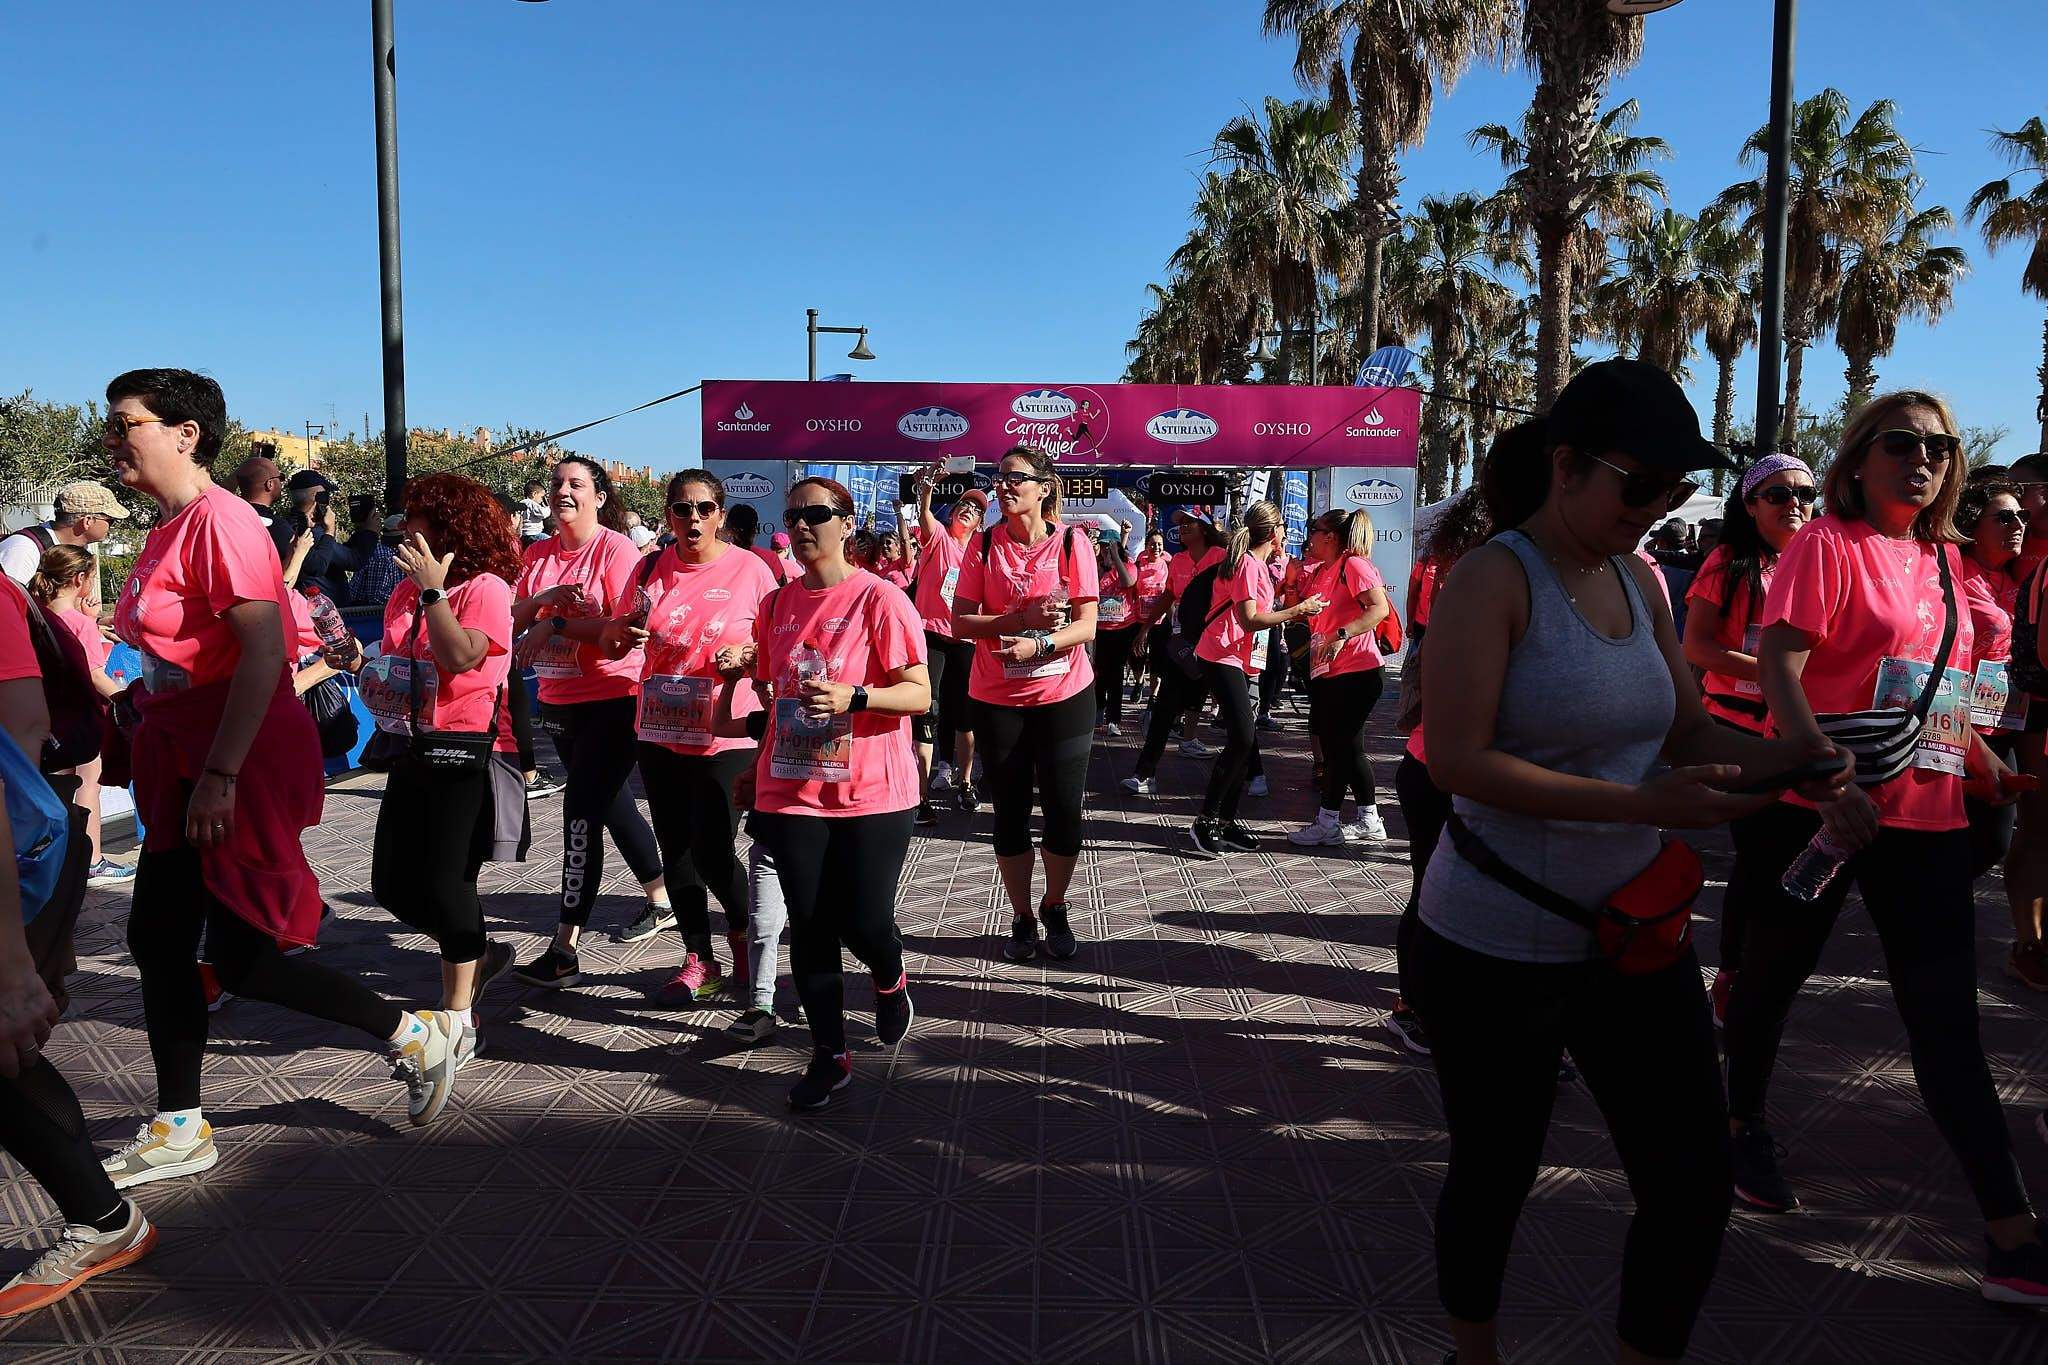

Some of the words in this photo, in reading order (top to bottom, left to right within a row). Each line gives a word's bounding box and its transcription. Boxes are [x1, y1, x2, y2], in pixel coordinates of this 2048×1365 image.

[1016, 401, 1072, 413] ASTURIANA
[717, 421, 771, 432] Santander
[805, 419, 862, 432] OYSHO
[902, 419, 963, 432] ASTURIANA
[1004, 417, 1060, 435] Carrera
[1151, 421, 1212, 434] ASTURIANA
[1253, 422, 1311, 435] OYSHO
[1345, 426, 1401, 437] Santander
[1017, 435, 1028, 447] de
[1030, 435, 1038, 447] la
[1038, 433, 1079, 460] Mujer
[724, 483, 770, 492] ASTURIANA
[911, 483, 964, 495] OSHO
[1067, 479, 1103, 495] 13:39
[1161, 483, 1215, 496] OYSHO
[1350, 489, 1398, 500] ASTURIANA
[1924, 712, 1951, 730] 16
[564, 818, 588, 908] adidas
